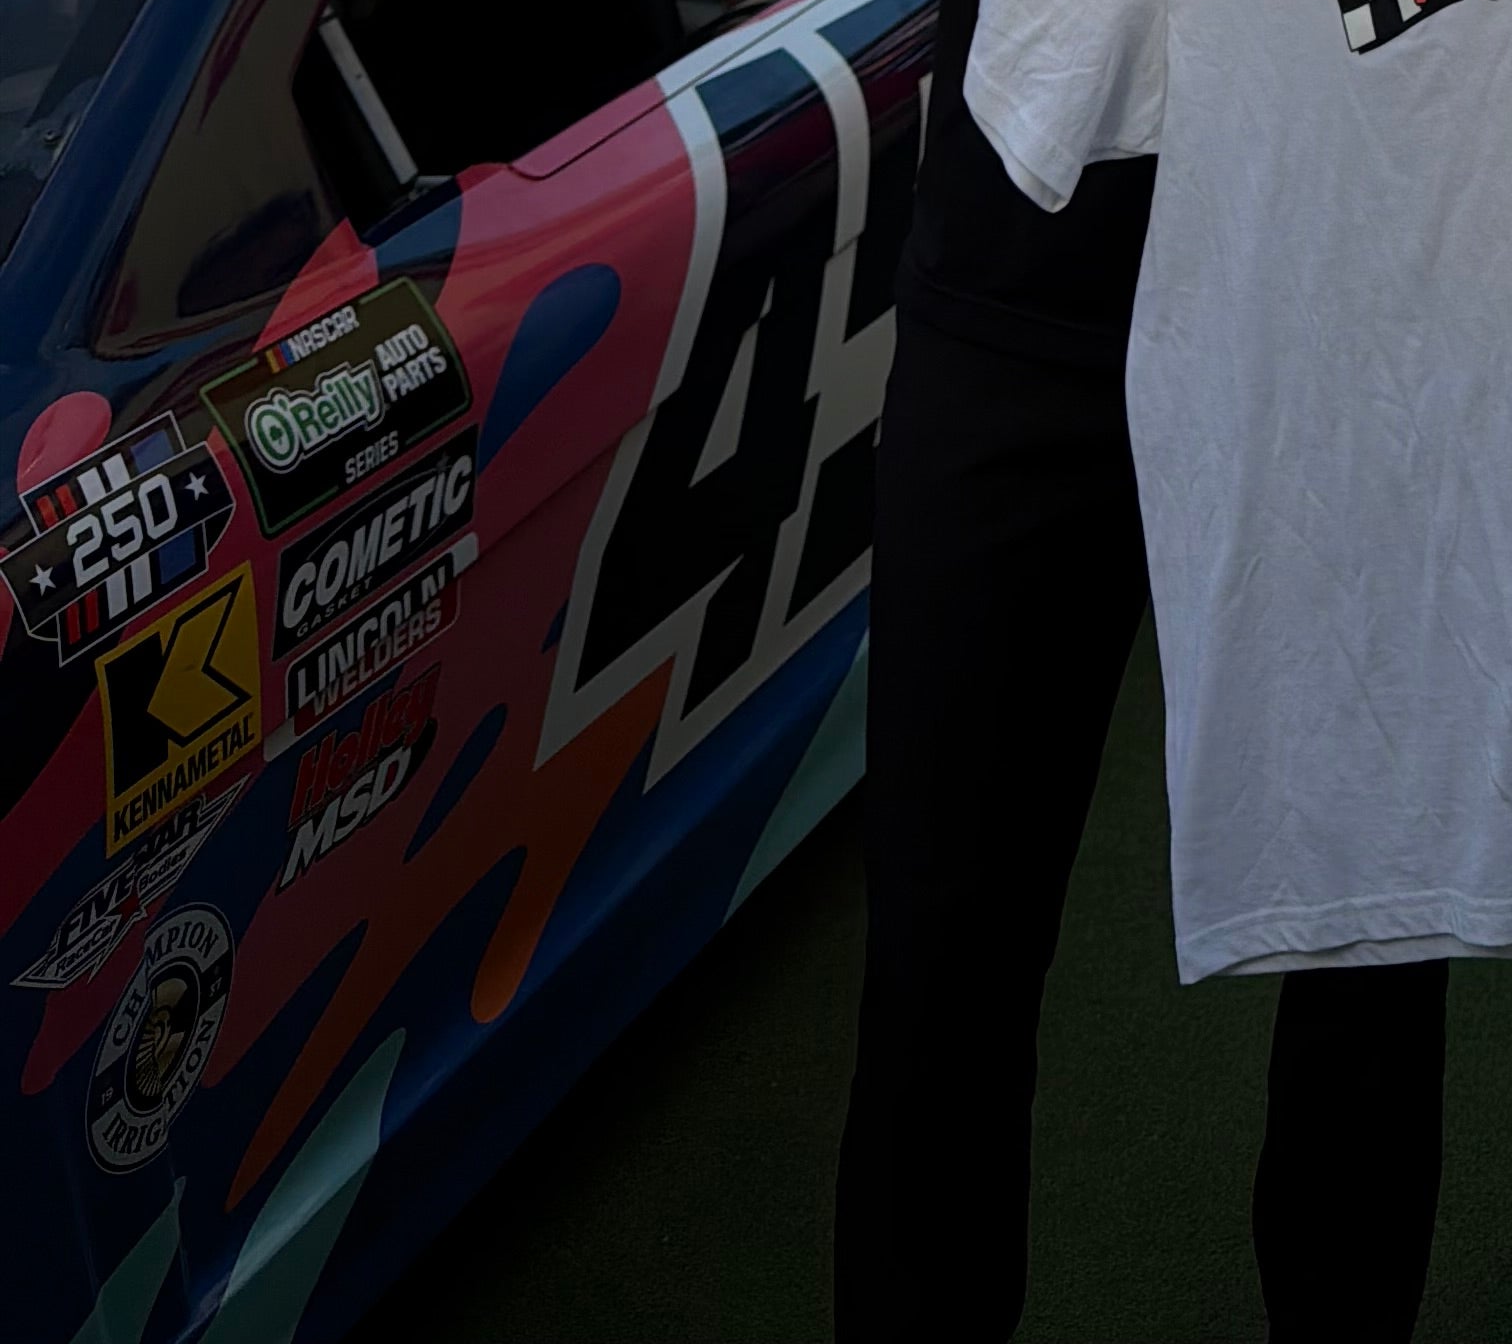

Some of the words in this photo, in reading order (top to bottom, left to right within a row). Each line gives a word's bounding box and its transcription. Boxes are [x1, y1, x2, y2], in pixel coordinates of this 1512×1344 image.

[254, 368, 377, 464] O'Reilly
[374, 323, 430, 372] AUTO
[287, 305, 361, 363] NASCAR
[381, 346, 448, 403] PARTS
[344, 430, 400, 485] SERIES
[66, 471, 178, 590] 250
[282, 454, 473, 630] COMETIC
[296, 578, 373, 638] GASKET
[312, 597, 442, 716] WELDERS
[113, 715, 255, 843] KENNAMETAL
[288, 664, 441, 831] Holley
[278, 746, 412, 889] MSD
[112, 921, 219, 1047] CHMPION
[102, 1019, 215, 1155] IRRIGTION
